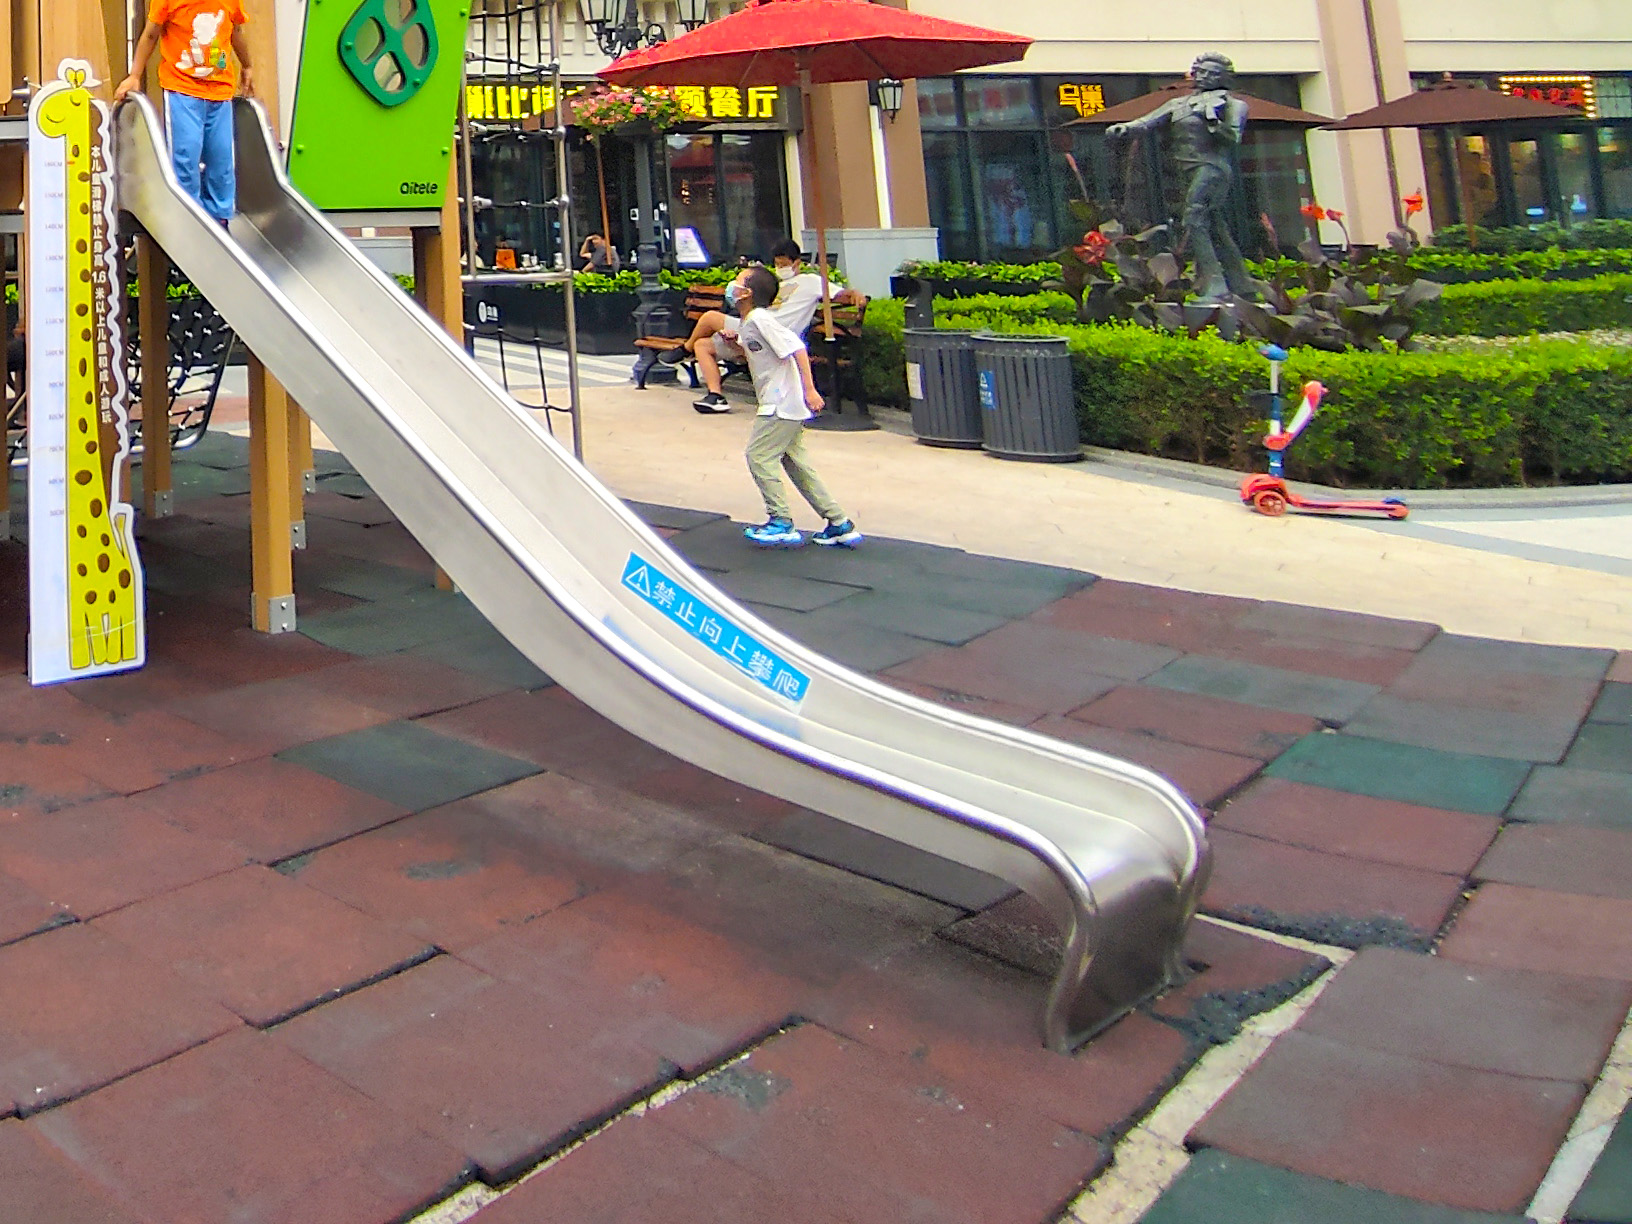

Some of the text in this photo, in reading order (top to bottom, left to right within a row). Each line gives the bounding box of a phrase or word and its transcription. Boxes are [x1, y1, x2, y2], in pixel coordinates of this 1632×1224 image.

[651, 580, 800, 697] 禁止向上攀爬
